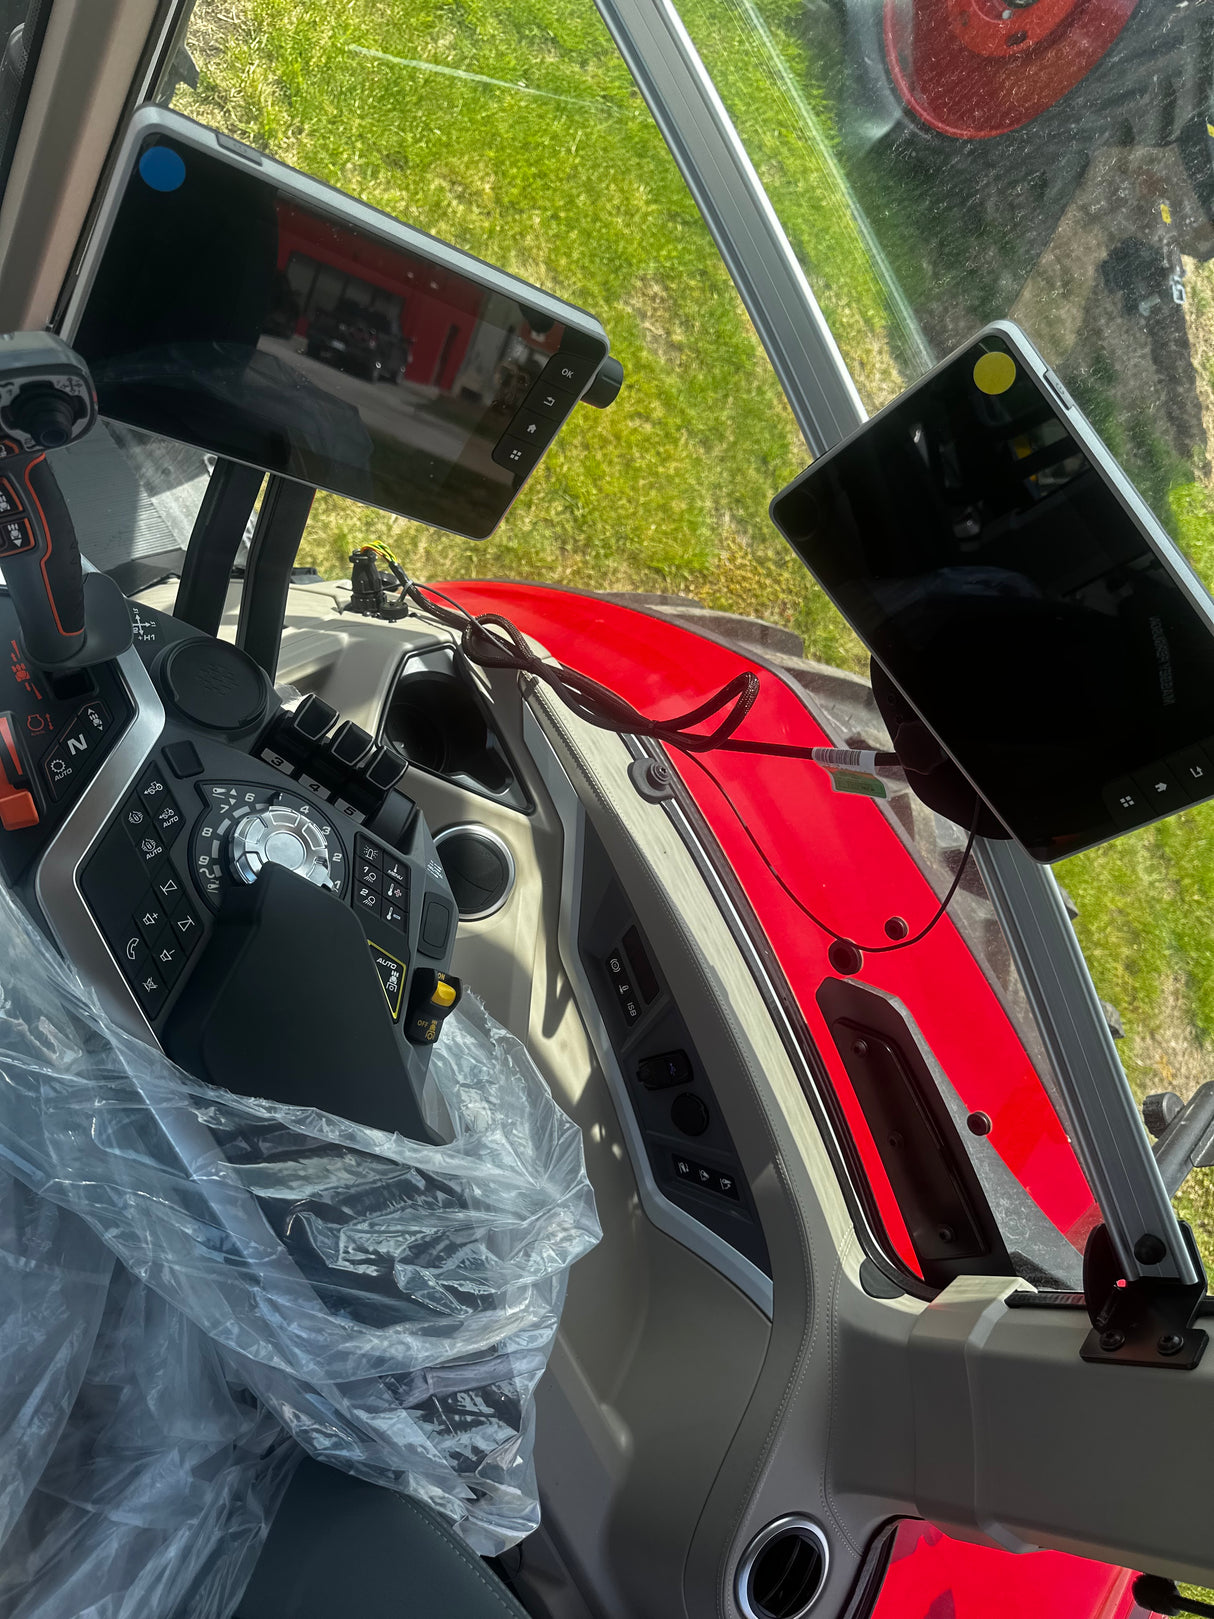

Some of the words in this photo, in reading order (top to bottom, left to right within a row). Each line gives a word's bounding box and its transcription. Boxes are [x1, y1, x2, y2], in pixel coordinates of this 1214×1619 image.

[561, 368, 575, 379] OK
[67, 733, 88, 756] N
[270, 756, 285, 767] 3
[54, 767, 73, 782] AUTO
[308, 781, 320, 792] 4
[244, 792, 255, 803] 6
[219, 804, 230, 814] 7
[300, 804, 310, 814] 4
[343, 806, 357, 816] 5
[162, 815, 179, 828] AUTO
[201, 827, 213, 837] 8
[321, 826, 331, 836] 3
[145, 846, 162, 860] AUTO
[332, 853, 343, 862] 2
[198, 855, 210, 866] 9
[363, 866, 369, 874] 1
[388, 869, 403, 881] MENU
[359, 888, 369, 897] 2
[376, 957, 397, 970] AUTO
[437, 972, 446, 981] ON
[626, 1002, 637, 1018] ISB
[417, 1020, 429, 1028] OFF
